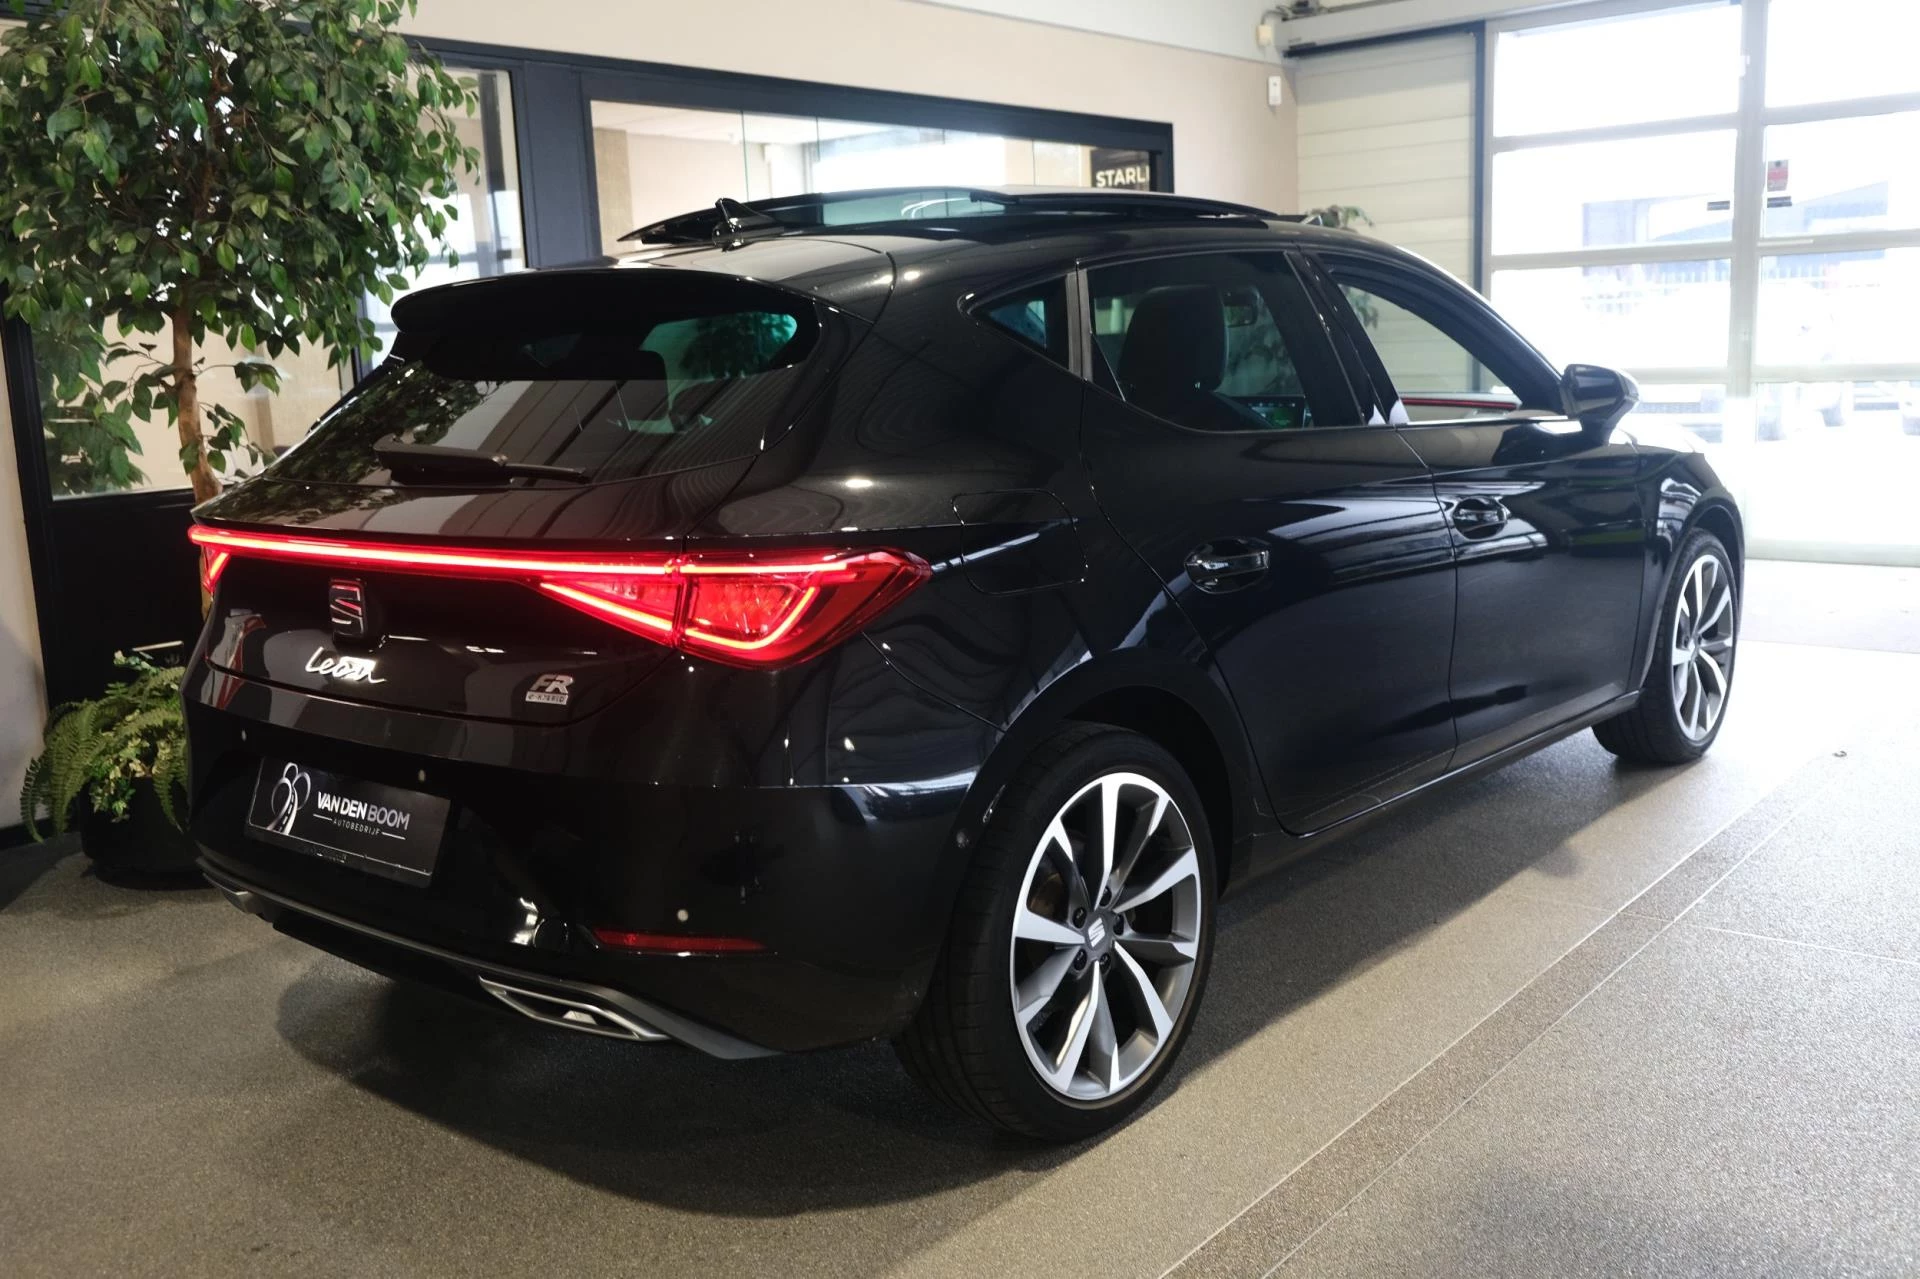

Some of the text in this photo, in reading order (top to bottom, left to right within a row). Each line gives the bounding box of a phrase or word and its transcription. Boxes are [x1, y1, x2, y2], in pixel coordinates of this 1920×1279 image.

[529, 674, 574, 694] FR
[317, 791, 411, 831] VAN DEN BOOM
[333, 818, 382, 836] AUTOBEDRIJF
